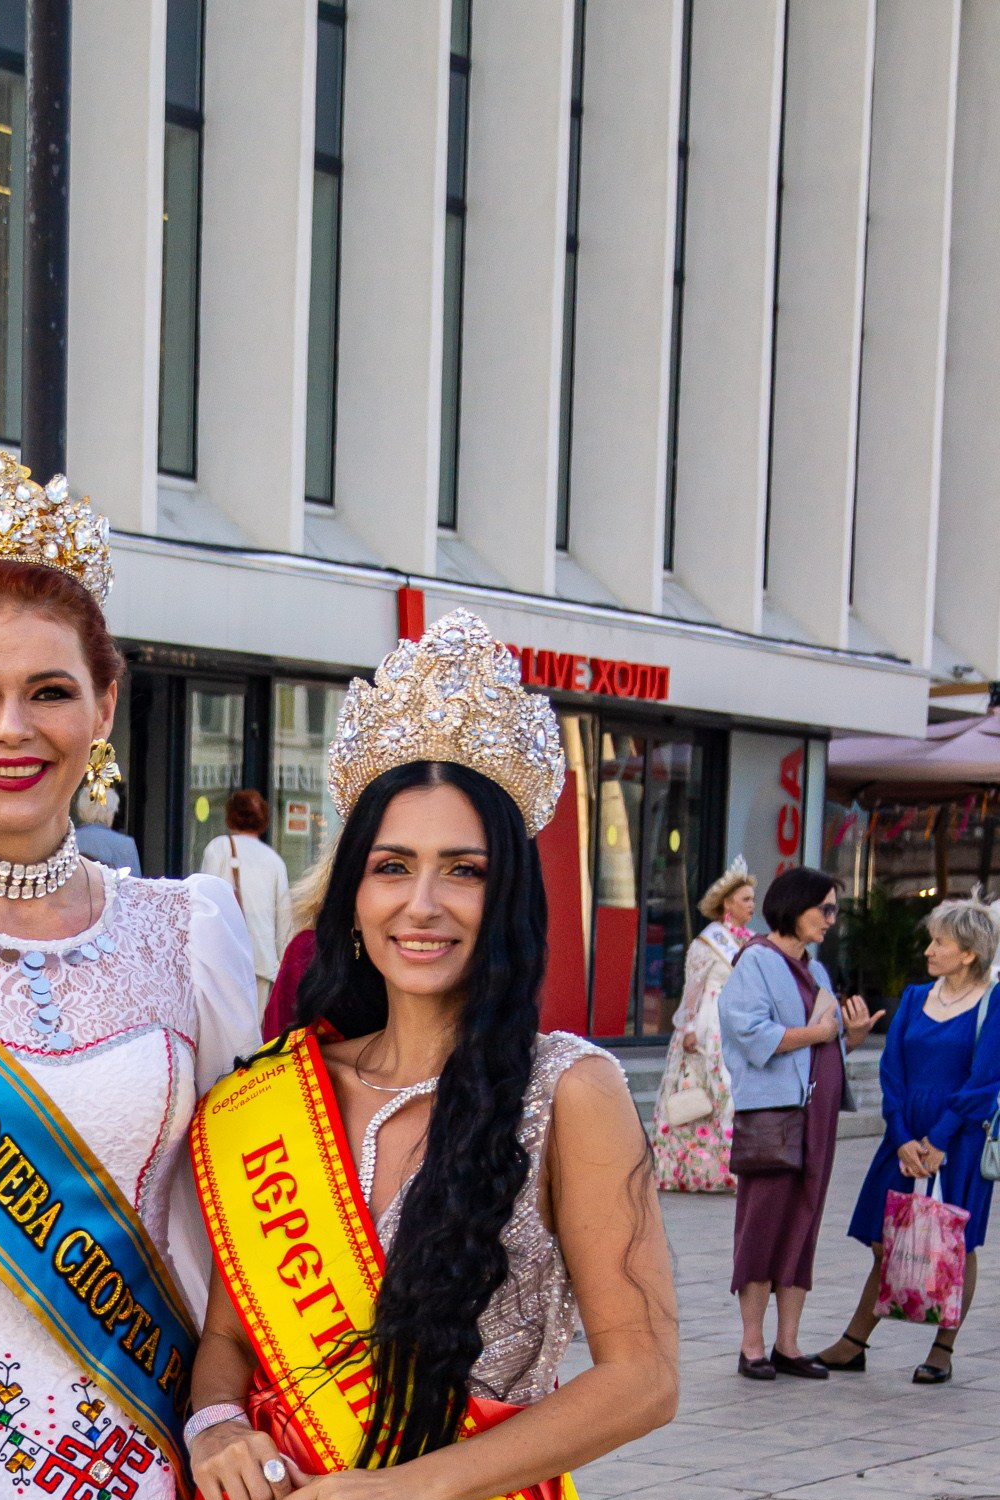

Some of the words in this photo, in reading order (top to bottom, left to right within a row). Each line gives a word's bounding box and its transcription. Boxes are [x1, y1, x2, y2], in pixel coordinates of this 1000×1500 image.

[521, 647, 587, 692] LIVE
[588, 657, 671, 701] ХОЛЛ
[212, 1064, 286, 1115] берегиня
[53, 1229, 161, 1374] СПОРТА
